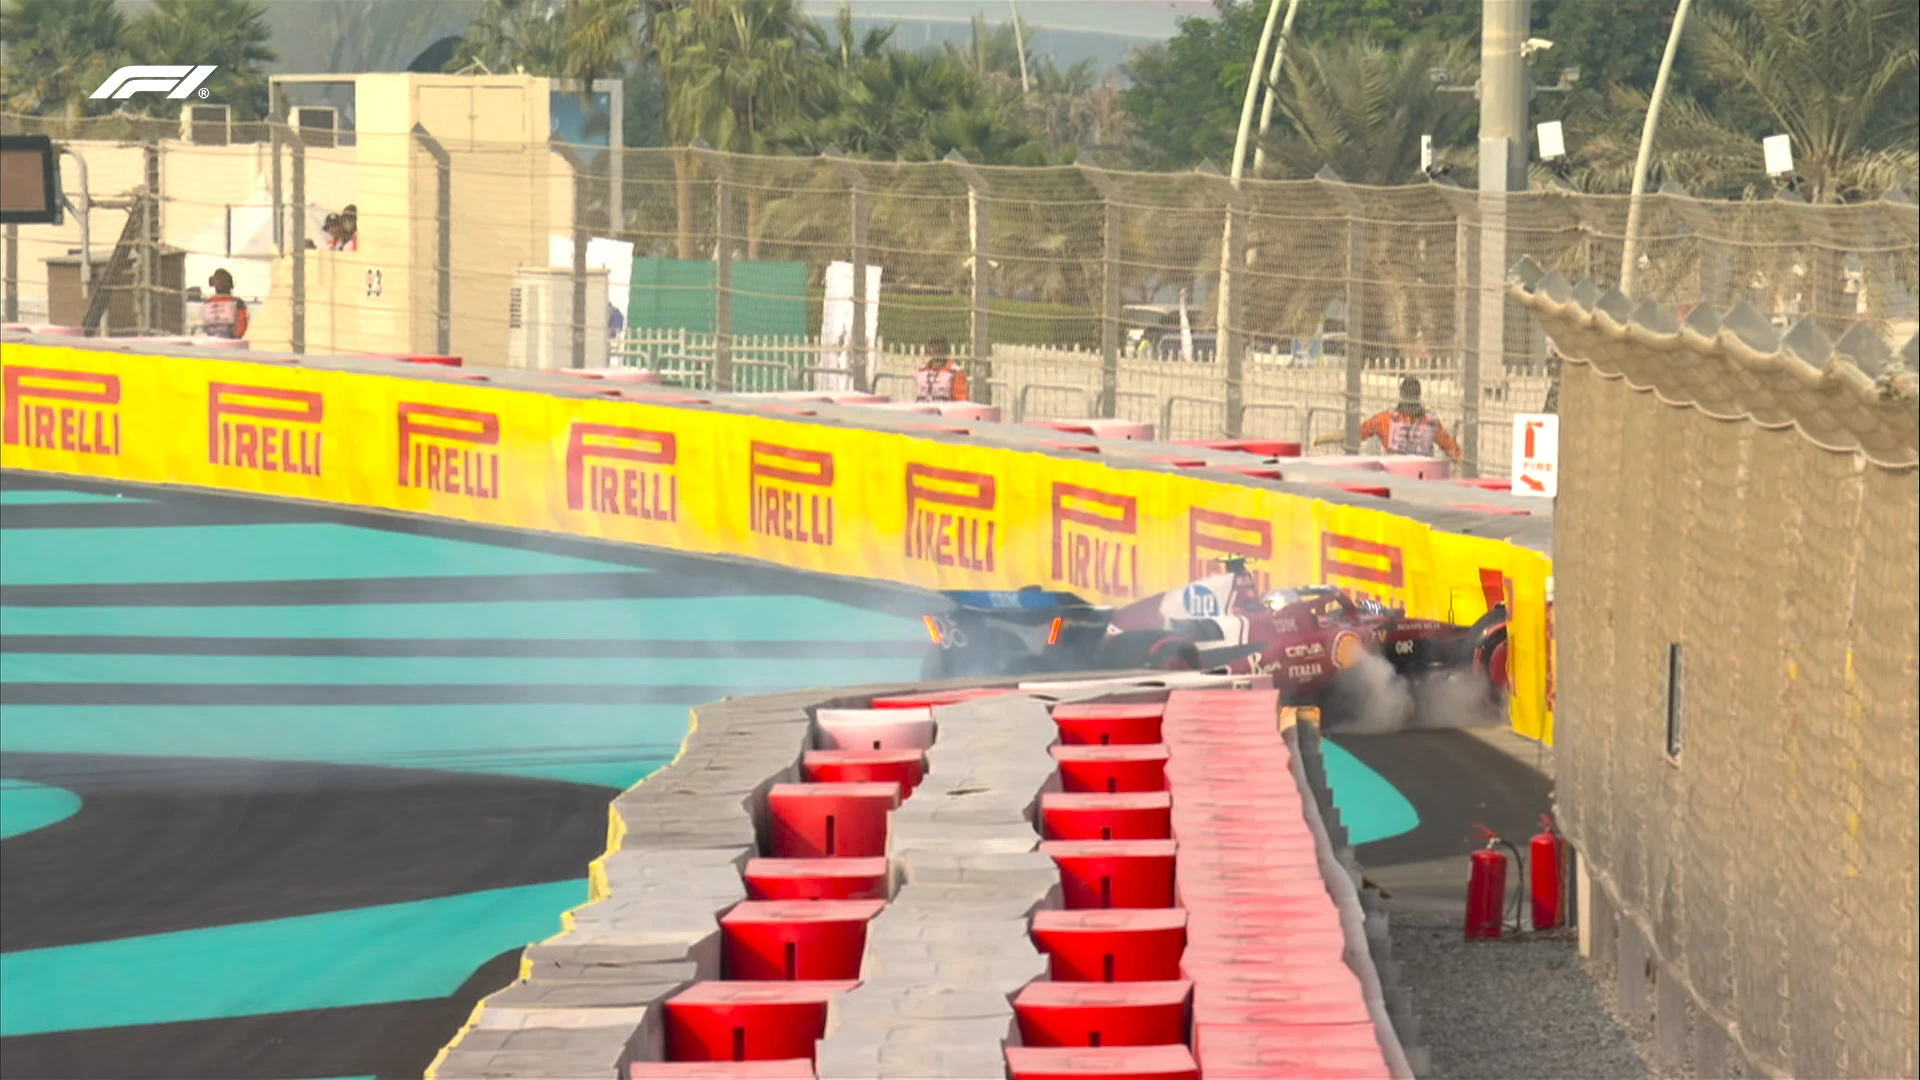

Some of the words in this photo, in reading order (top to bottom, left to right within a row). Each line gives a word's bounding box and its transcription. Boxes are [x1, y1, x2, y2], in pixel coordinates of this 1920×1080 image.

[4, 364, 121, 456] PIRELLI
[208, 381, 324, 476] PIRELLI
[398, 400, 500, 499] PIRELLI
[566, 422, 678, 522] PIRELLI
[750, 440, 834, 546] PIRELLI
[1523, 461, 1553, 472] FIRE
[905, 462, 996, 572] PIRELLI
[1188, 585, 1218, 617] hp
[1285, 642, 1326, 658] CEVA
